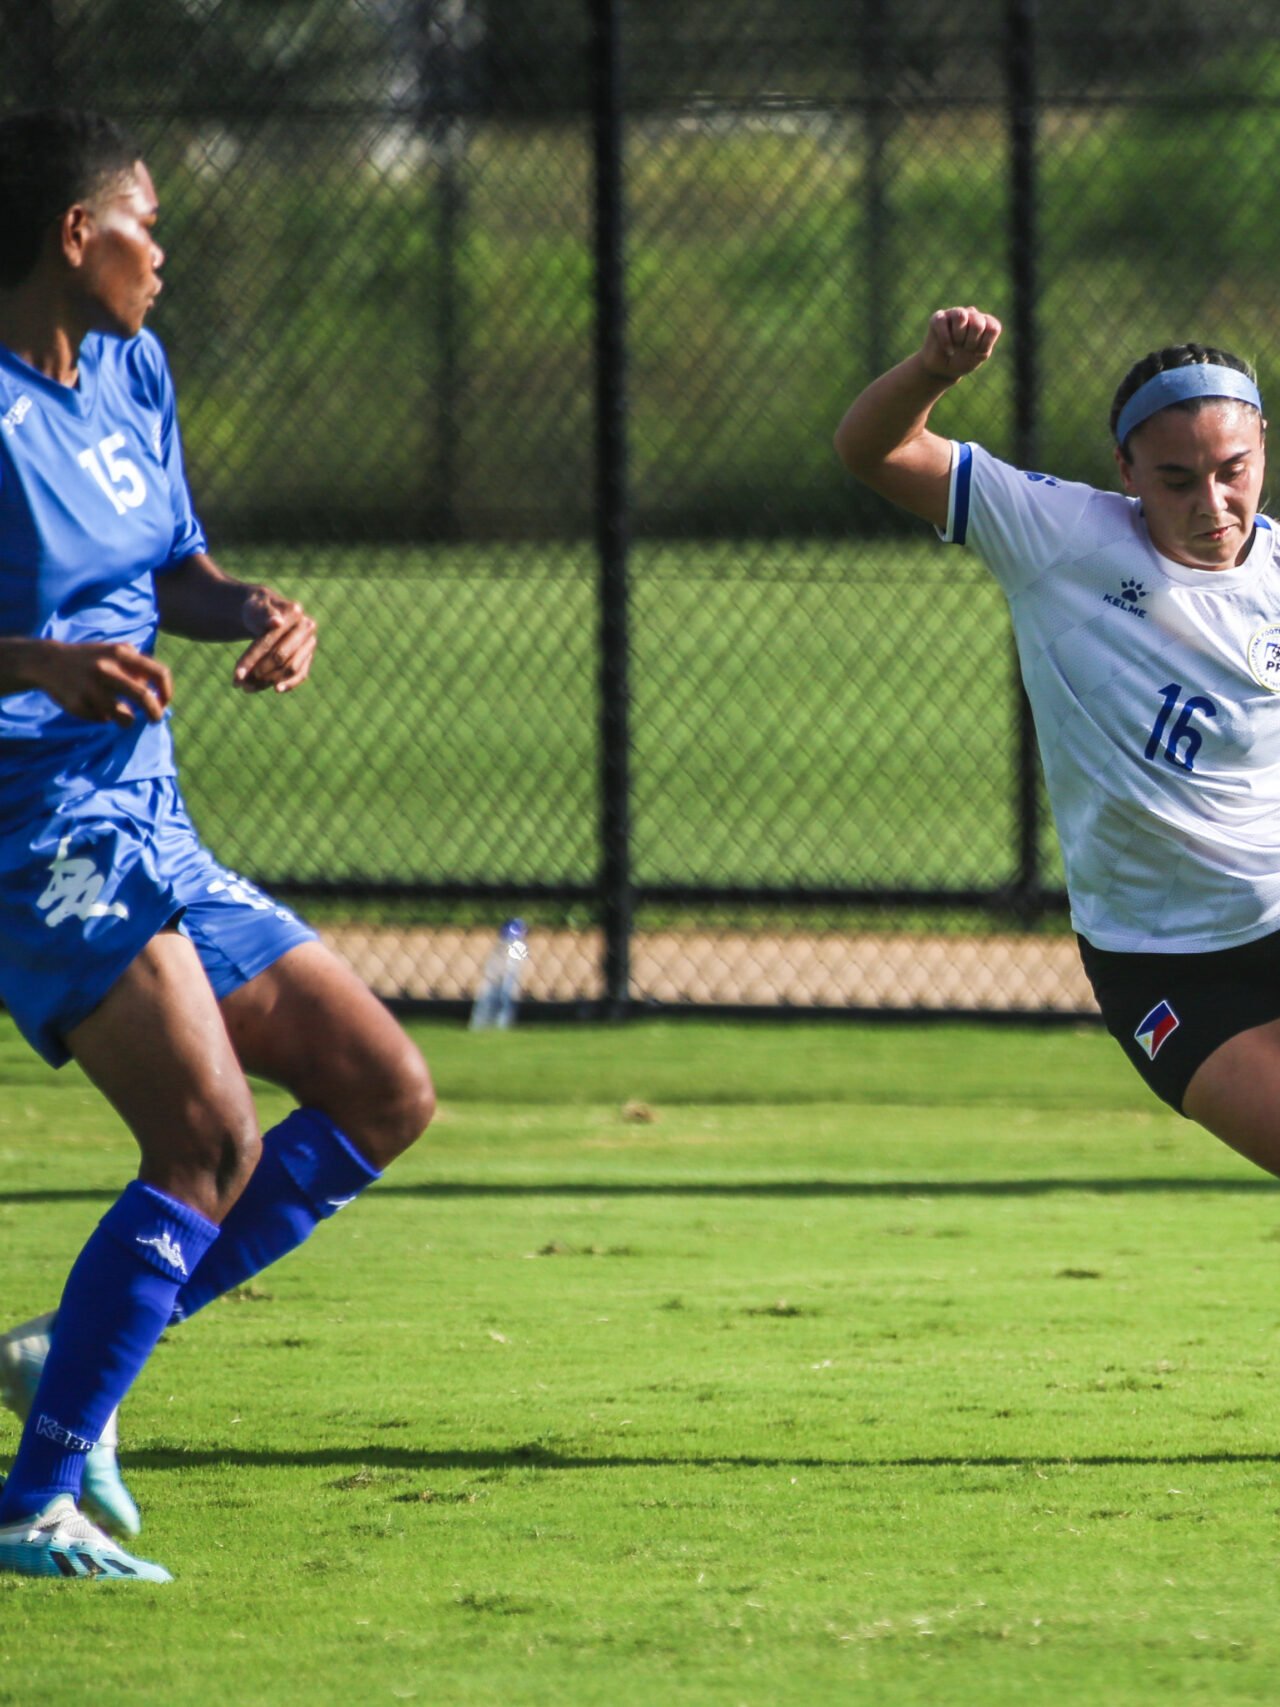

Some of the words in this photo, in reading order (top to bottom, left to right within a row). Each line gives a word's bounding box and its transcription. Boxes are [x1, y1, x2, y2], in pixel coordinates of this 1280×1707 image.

[77, 432, 147, 516] 15
[1103, 593, 1147, 619] KELME
[1144, 683, 1217, 772] 16
